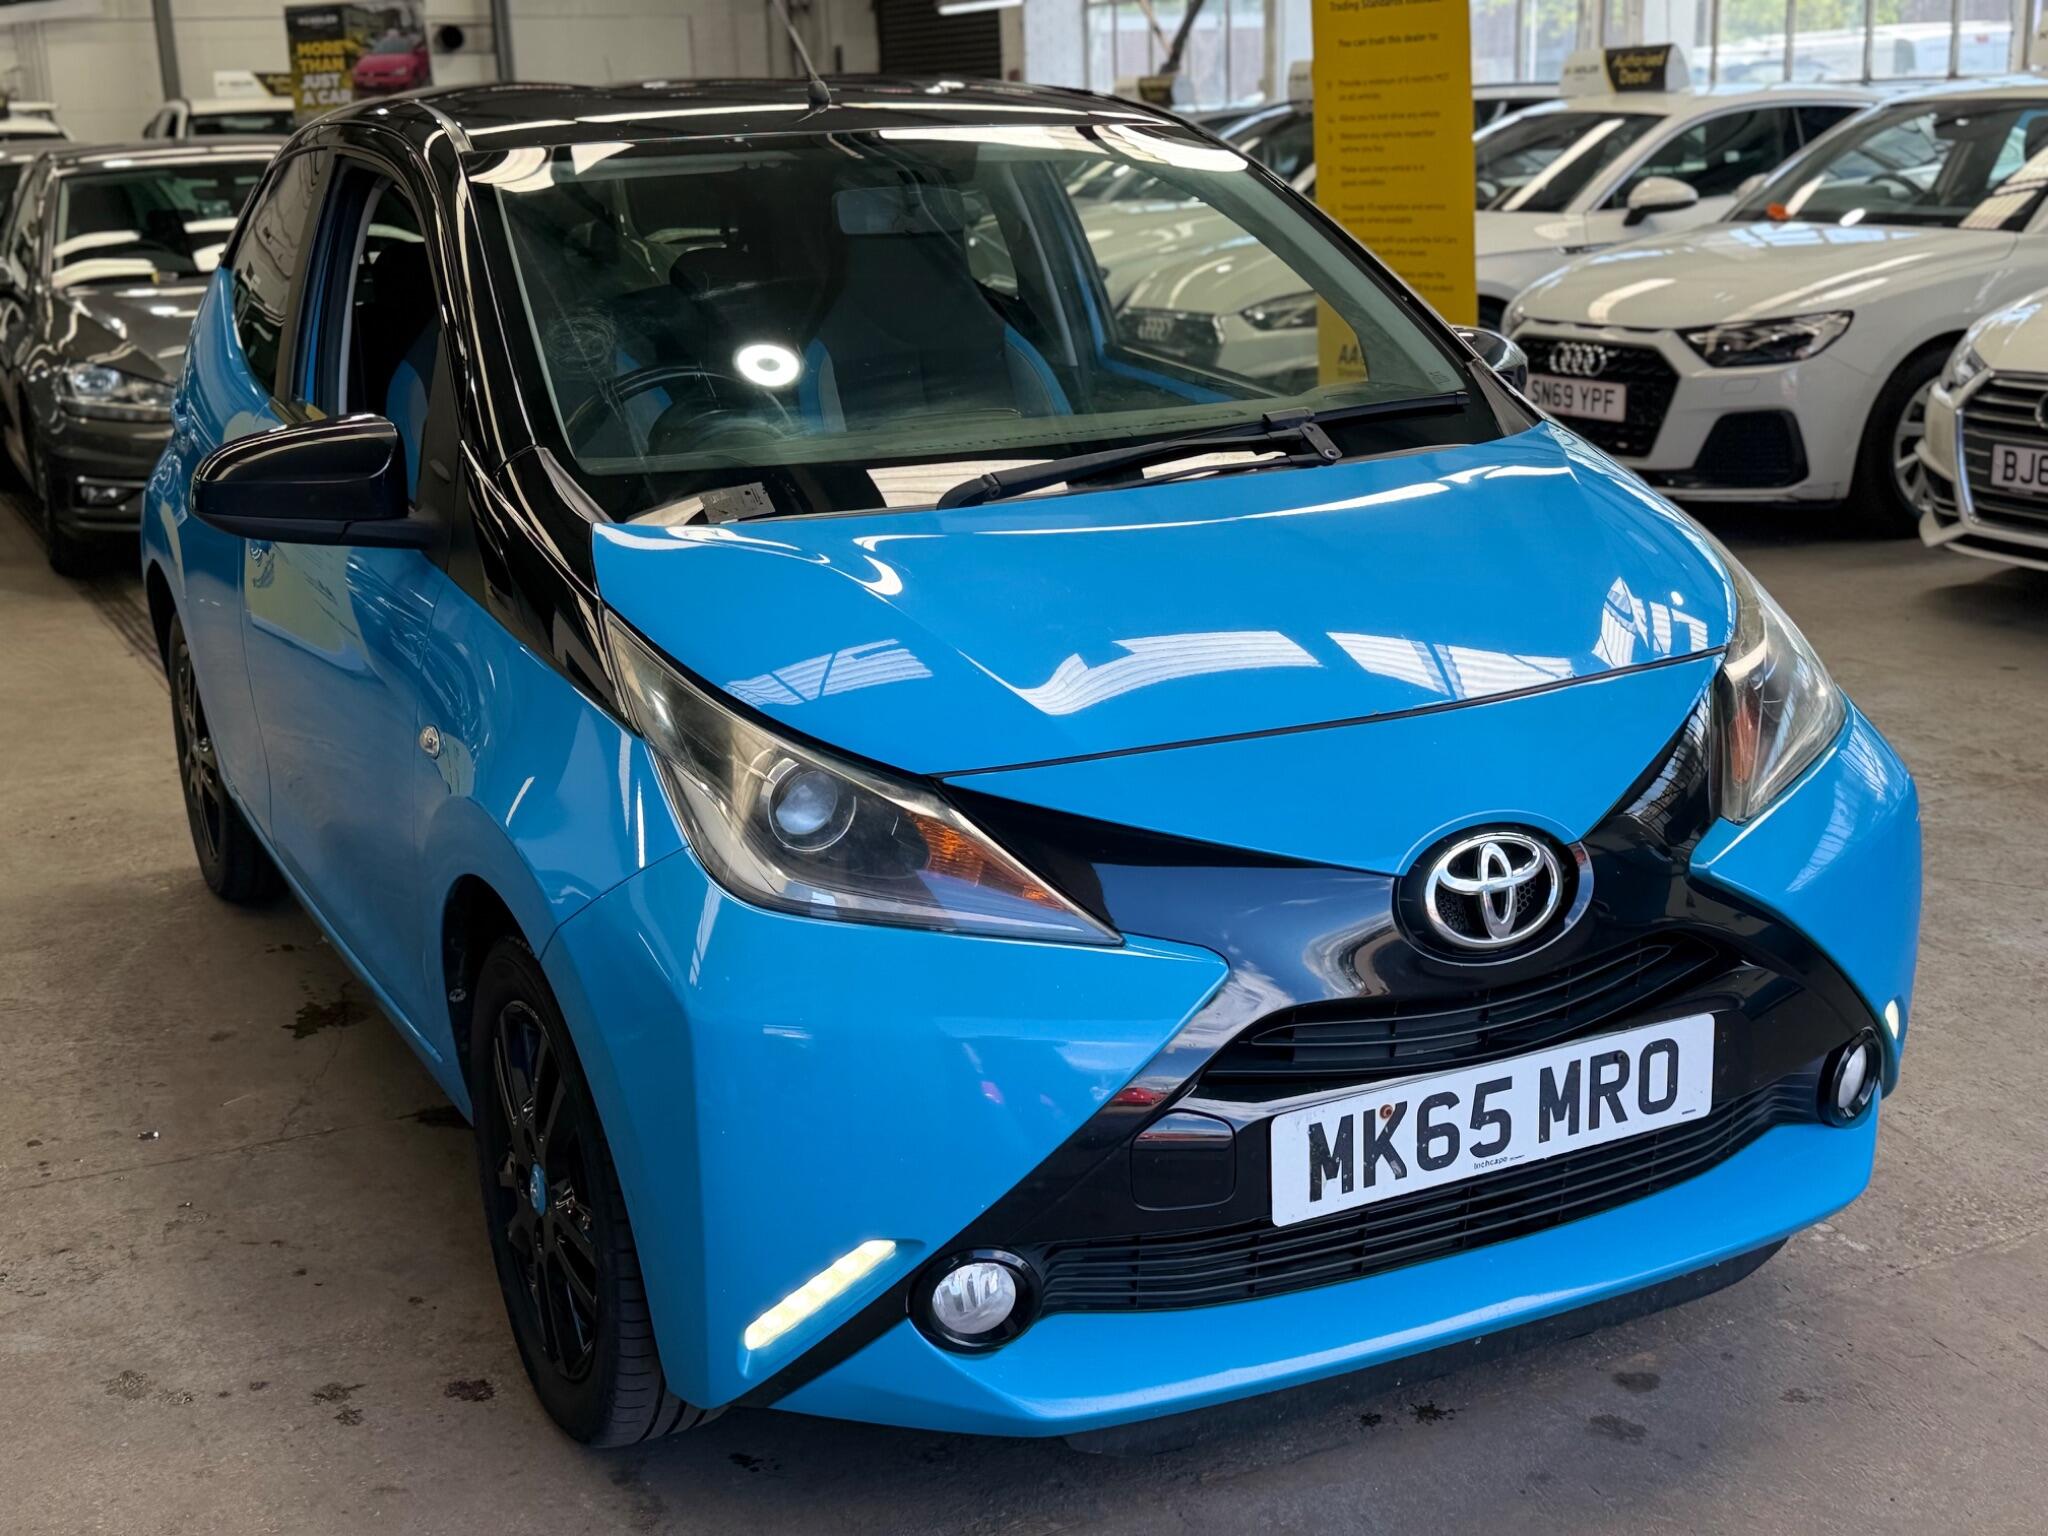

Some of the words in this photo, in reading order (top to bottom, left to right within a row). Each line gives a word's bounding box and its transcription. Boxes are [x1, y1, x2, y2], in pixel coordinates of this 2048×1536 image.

[299, 58, 344, 72] THAN
[301, 74, 341, 88] JUST
[1531, 380, 1574, 409] SN69
[1580, 386, 1615, 413] YPF
[1308, 1076, 1513, 1203] MK65
[1538, 1038, 1679, 1144] MRO
